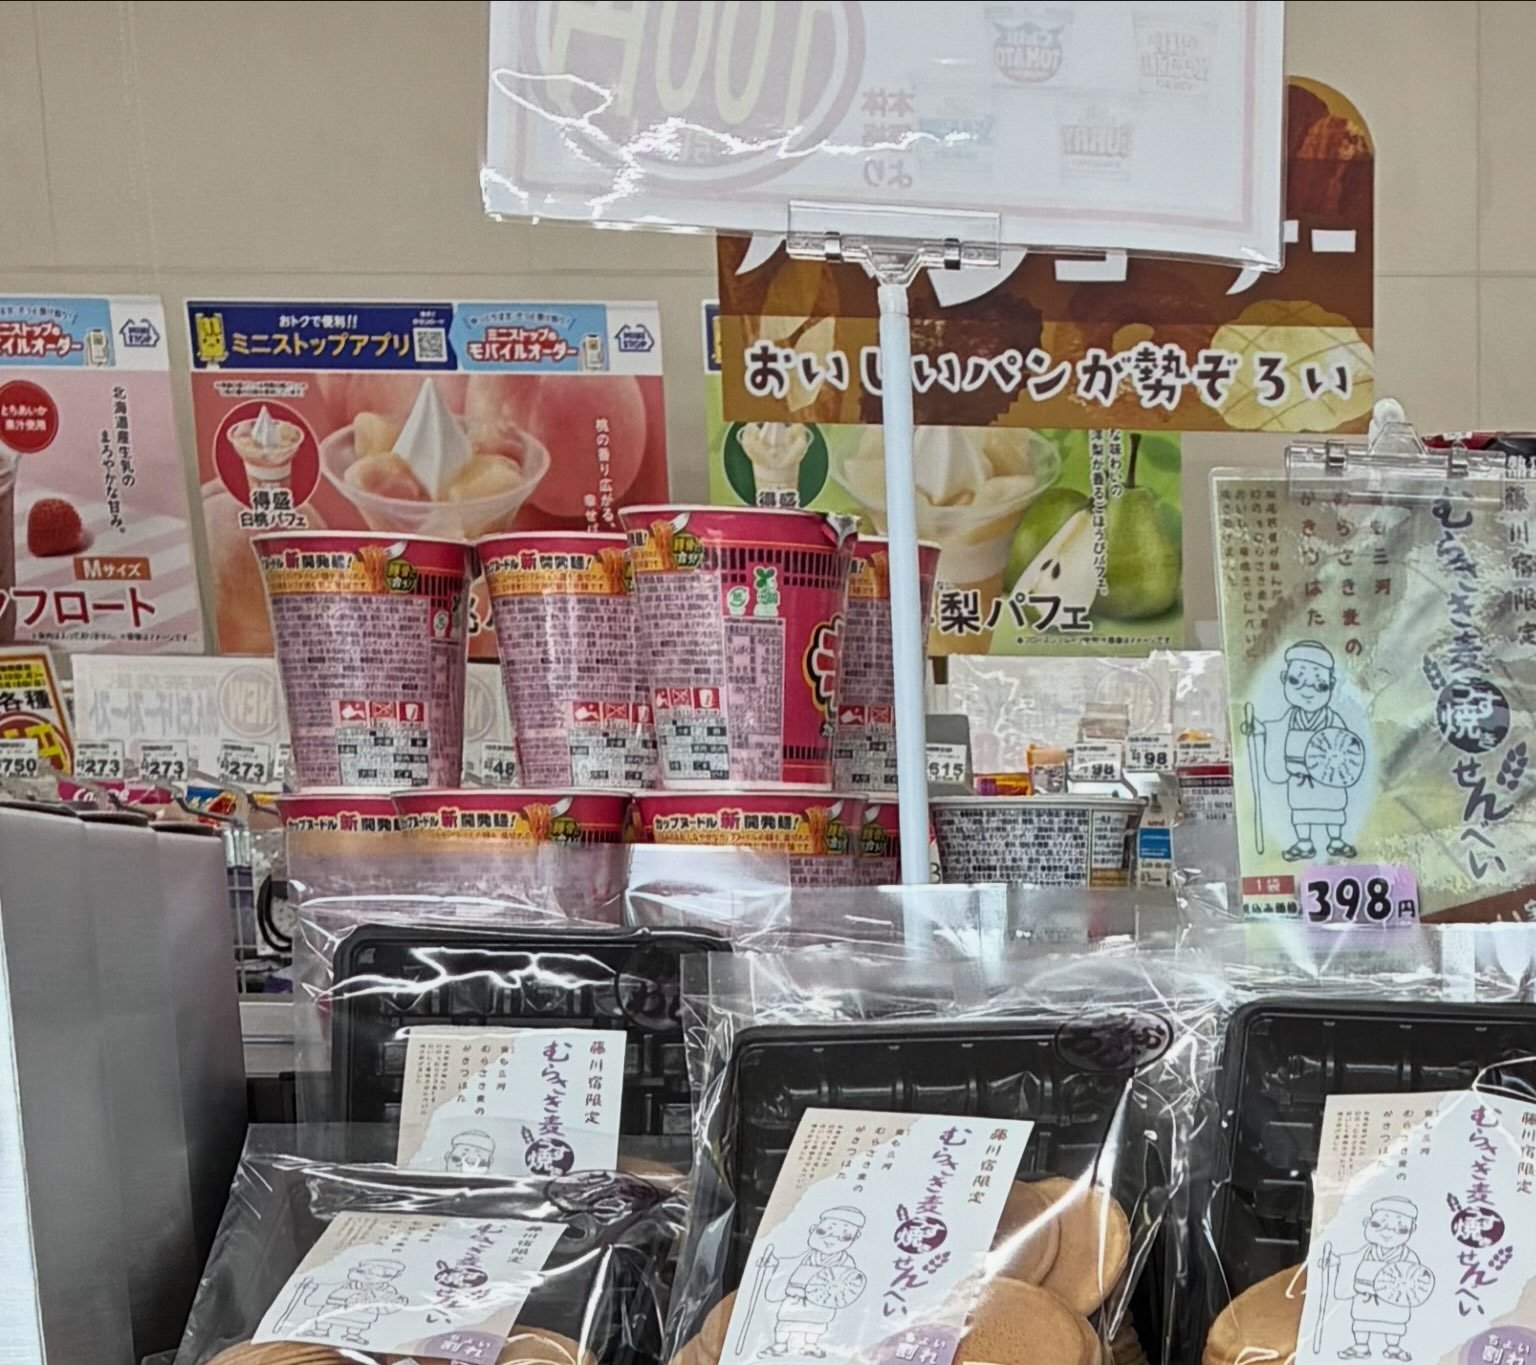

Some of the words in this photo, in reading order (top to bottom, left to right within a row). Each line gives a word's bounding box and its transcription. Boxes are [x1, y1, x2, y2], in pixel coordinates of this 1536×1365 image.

[231, 331, 410, 357] ミニストップアプリ
[468, 340, 578, 361] モバイルオーダー
[241, 512, 308, 529] 白桃パフェ
[83, 561, 143, 579] Mサイズ
[584, 1040, 607, 1125] 藤川宿限定
